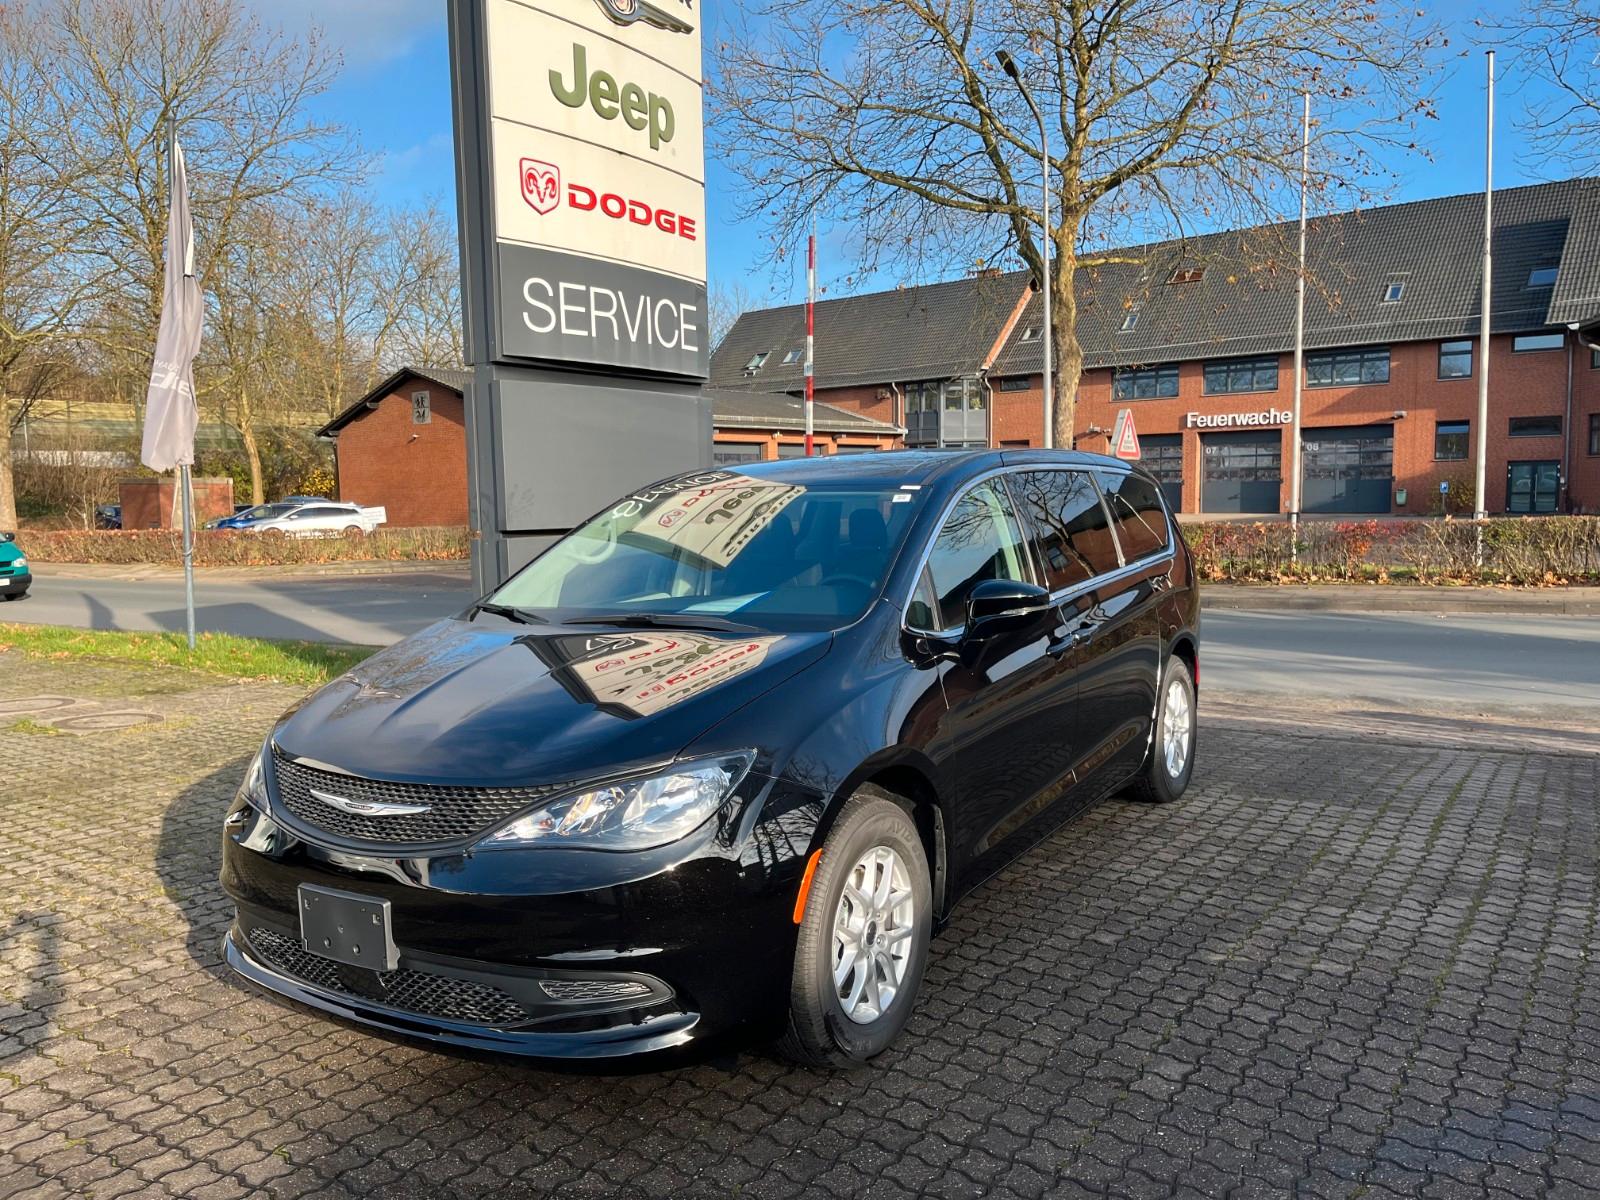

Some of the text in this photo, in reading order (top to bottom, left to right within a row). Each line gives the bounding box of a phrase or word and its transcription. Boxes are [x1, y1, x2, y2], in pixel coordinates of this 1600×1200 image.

[548, 42, 675, 151] Jeep
[568, 183, 697, 241] DODGE
[522, 277, 699, 353] SERVICE
[1186, 407, 1293, 428] Feuerwache
[1205, 446, 1217, 455] 07
[1306, 442, 1319, 451] 08
